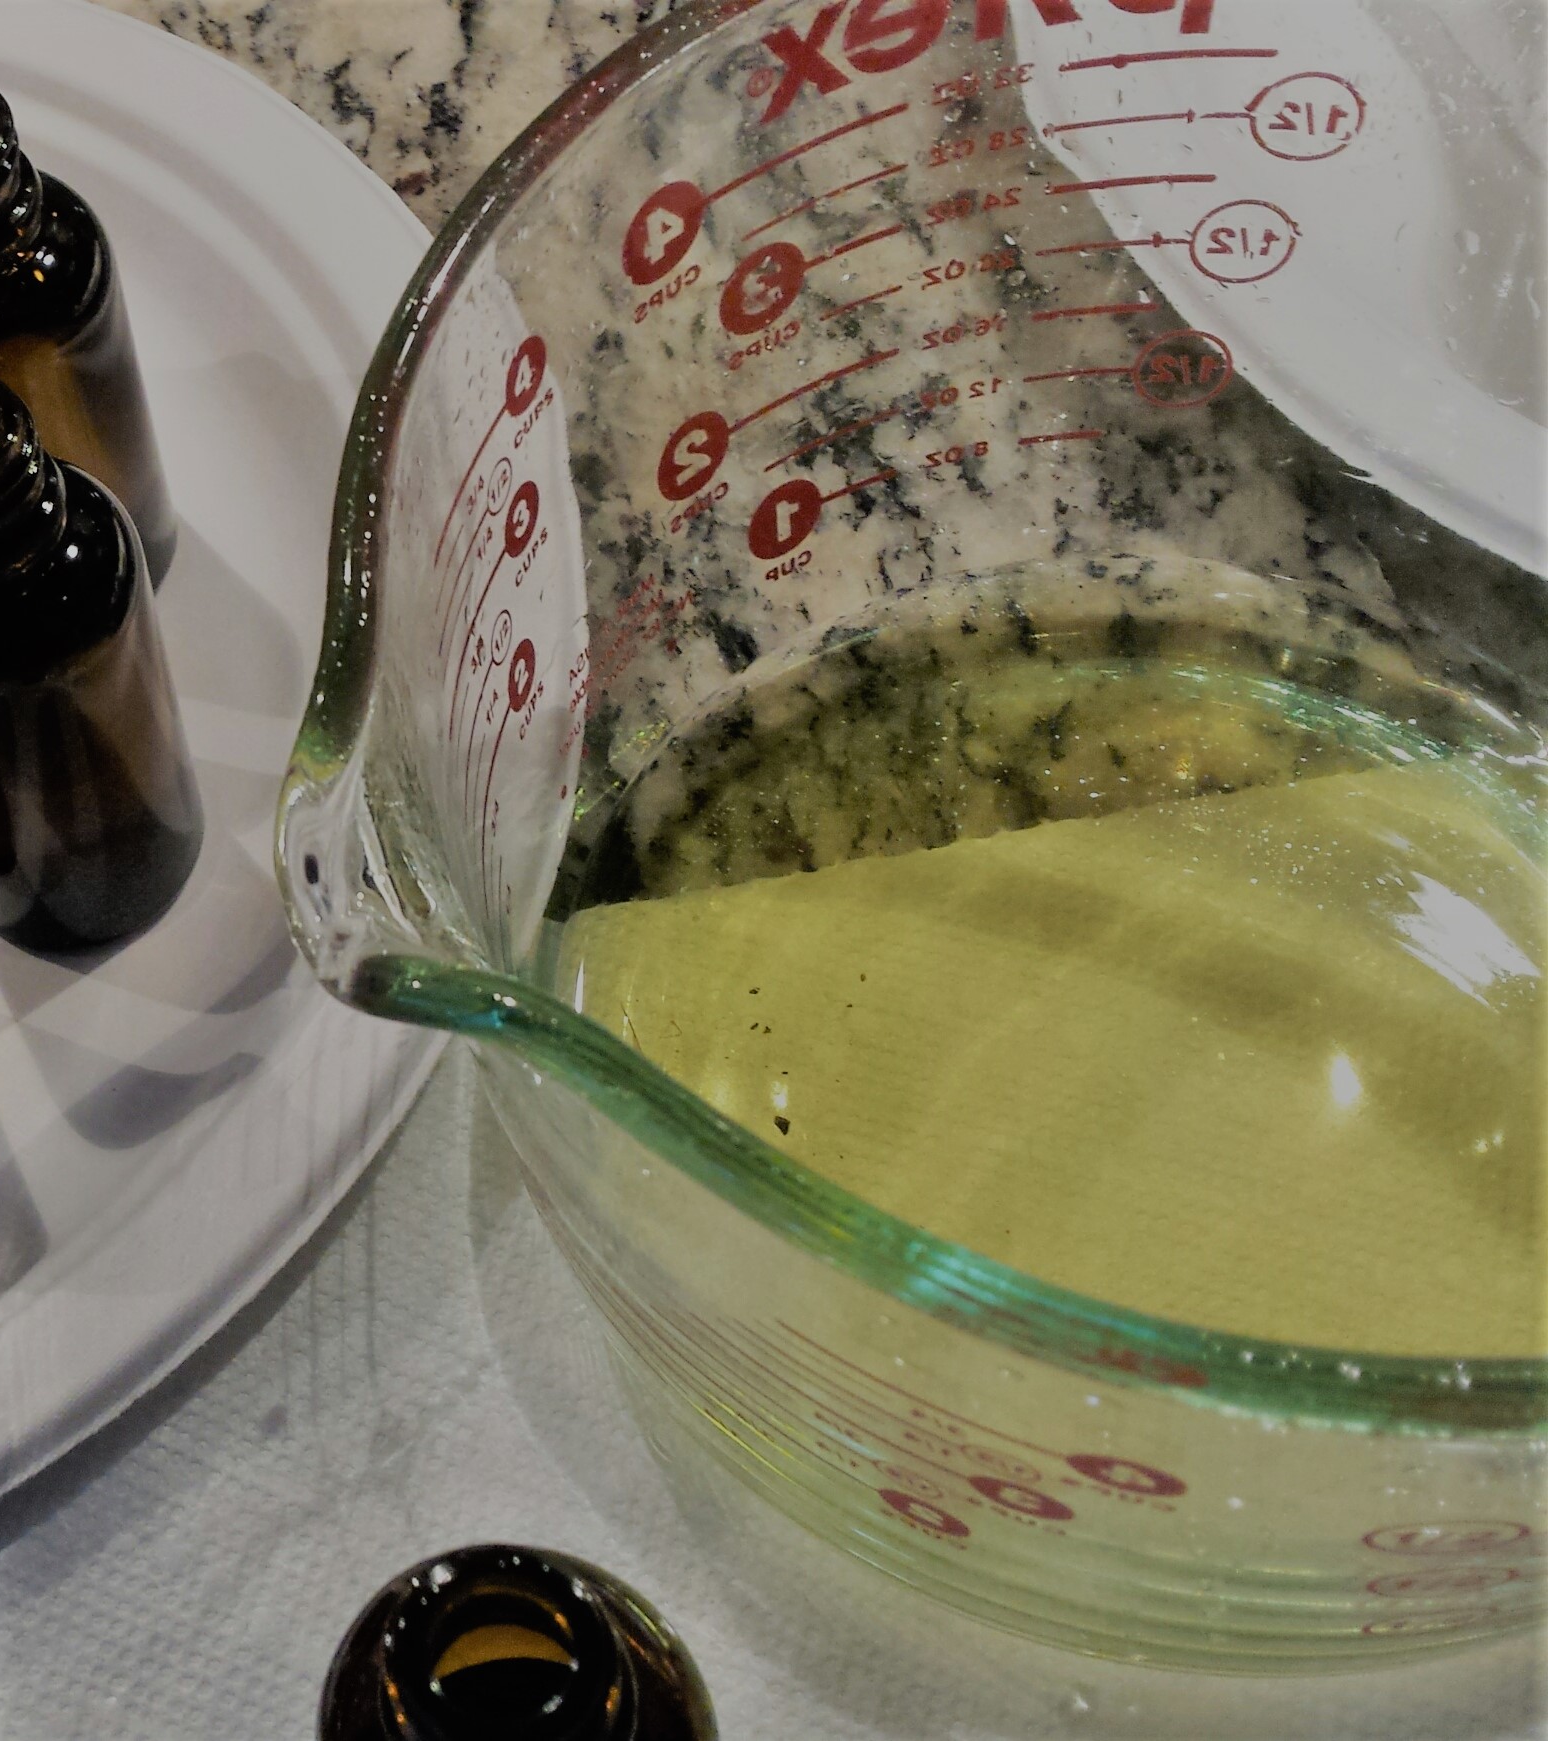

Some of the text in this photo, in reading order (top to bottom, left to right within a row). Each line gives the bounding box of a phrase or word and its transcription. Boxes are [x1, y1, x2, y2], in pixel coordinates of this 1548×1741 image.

[514, 355, 533, 397] 4
[514, 388, 554, 449] CUPS
[513, 500, 530, 538] 3
[515, 527, 548, 588] CUPS
[514, 658, 529, 695] 2
[519, 681, 544, 740] CUPS
